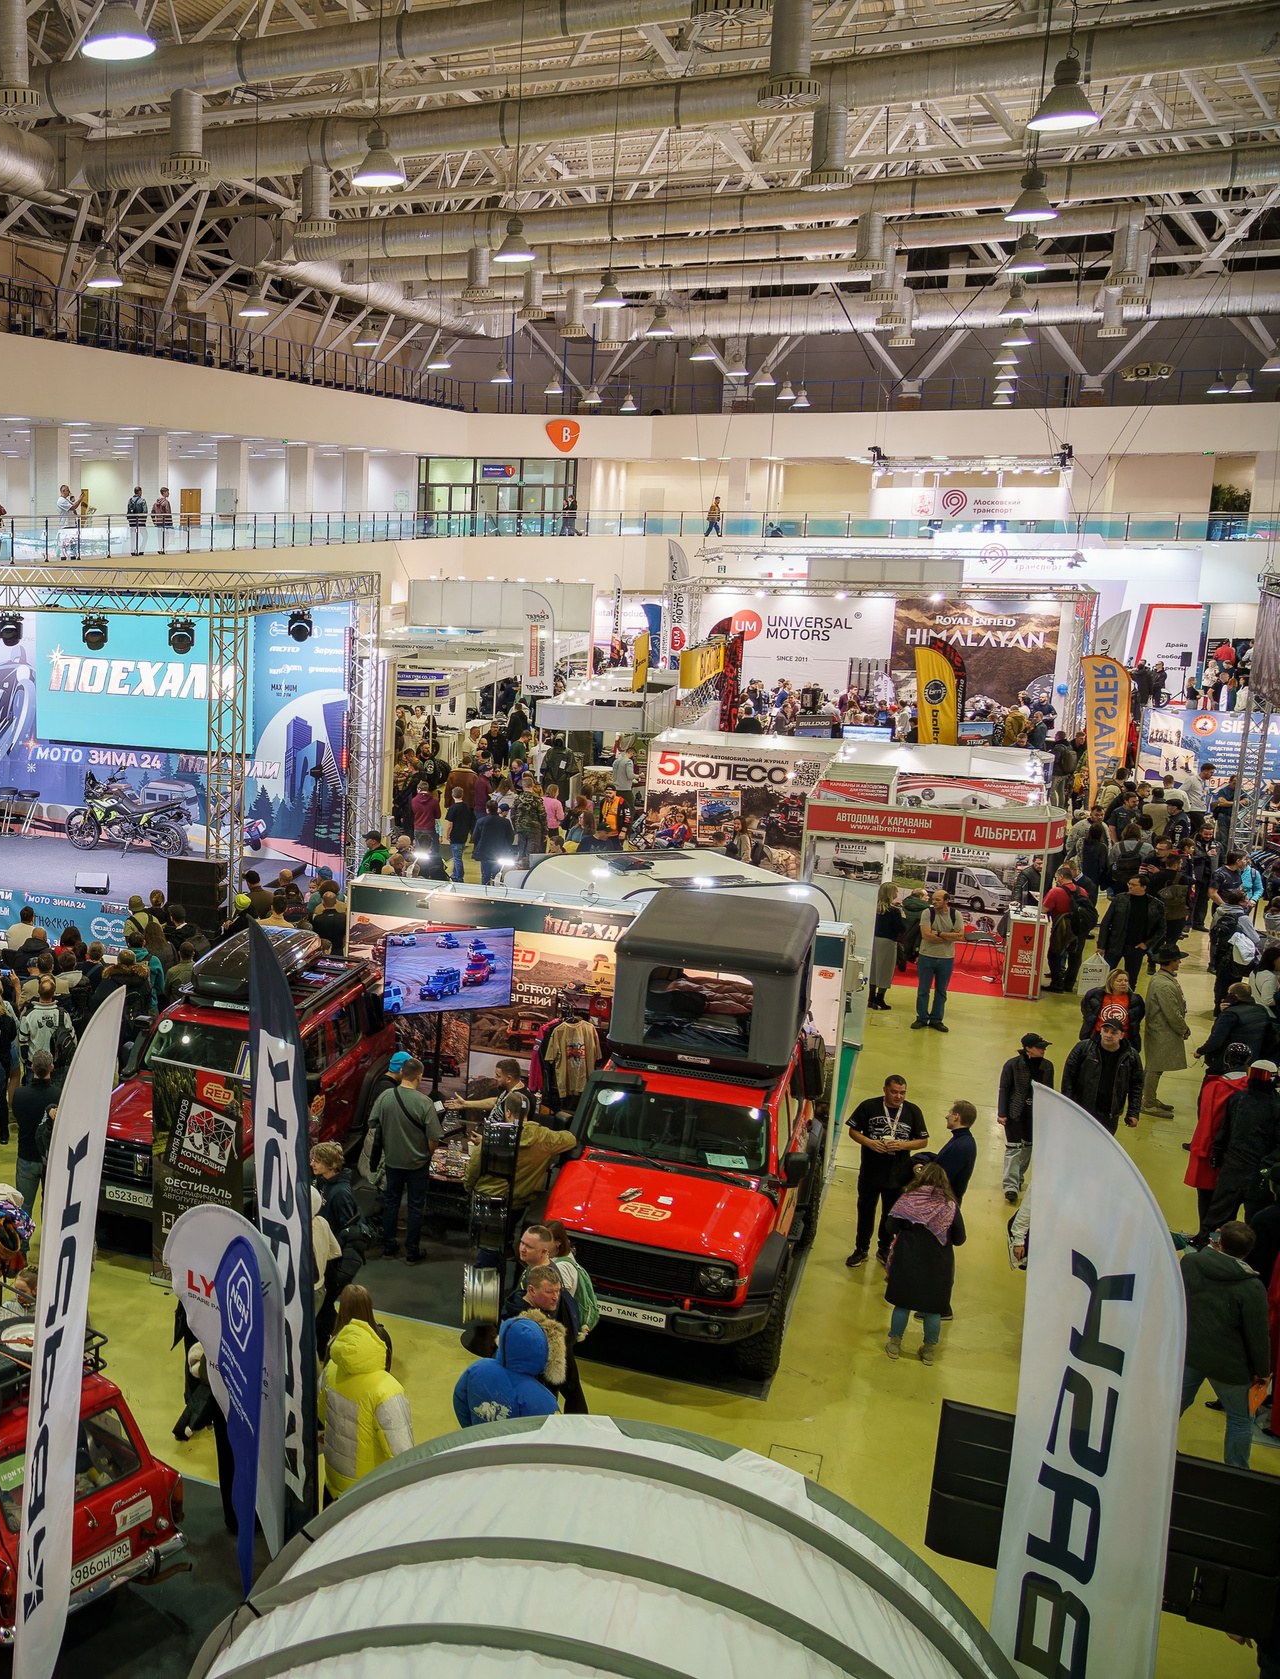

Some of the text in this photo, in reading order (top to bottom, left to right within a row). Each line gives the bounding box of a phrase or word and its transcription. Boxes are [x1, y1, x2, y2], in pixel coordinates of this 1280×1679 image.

[735, 620, 757, 632] UM
[767, 615, 853, 630] UNIVERSAL
[935, 615, 1017, 627] ROYAL ENFIELD
[766, 628, 830, 641] MOTORS
[905, 628, 1046, 649] HIMALAYAN
[49, 656, 241, 701] ПОЕХАЛИ
[37, 747, 162, 769] МОТО ЗИМА 24
[710, 754, 762, 763] АВТОМОБИЛЬНЫЙ
[656, 778, 705, 788] 5KOLESO.RU
[836, 812, 879, 825] АВТОДОМА
[887, 815, 932, 829] КАРАВАНЫ
[850, 823, 916, 834] www.albrehta.ru
[973, 825, 1037, 842] АЛЬБРЕХТА
[28, 895, 86, 909] МОТО ЗИМА 24
[100, 901, 133, 916] ПОЕХ
[543, 916, 625, 941] ПОЕХА
[513, 949, 536, 964] ED
[818, 970, 835, 978] RED
[516, 982, 563, 996] OFFROA
[511, 993, 552, 1007] ВГЕНИЙ
[205, 1087, 232, 1101] RED
[169, 1099, 189, 1165] ЗЕМЛЯ ВОГУЛОВ
[180, 1148, 226, 1174] КОЧУЮЩИЙ
[177, 1162, 202, 1176] СЛОН
[164, 1176, 233, 1199] ФЕСТИВАЛЬ
[622, 1204, 667, 1218] RED
[187, 1269, 215, 1299] LY
[187, 1292, 210, 1307] SPARE
[230, 1283, 249, 1325] NGN
[617, 1307, 638, 1319] TANK
[642, 1313, 664, 1324] SHOP
[0, 1470, 17, 1482] IKON
[111, 1543, 130, 1560] 790
